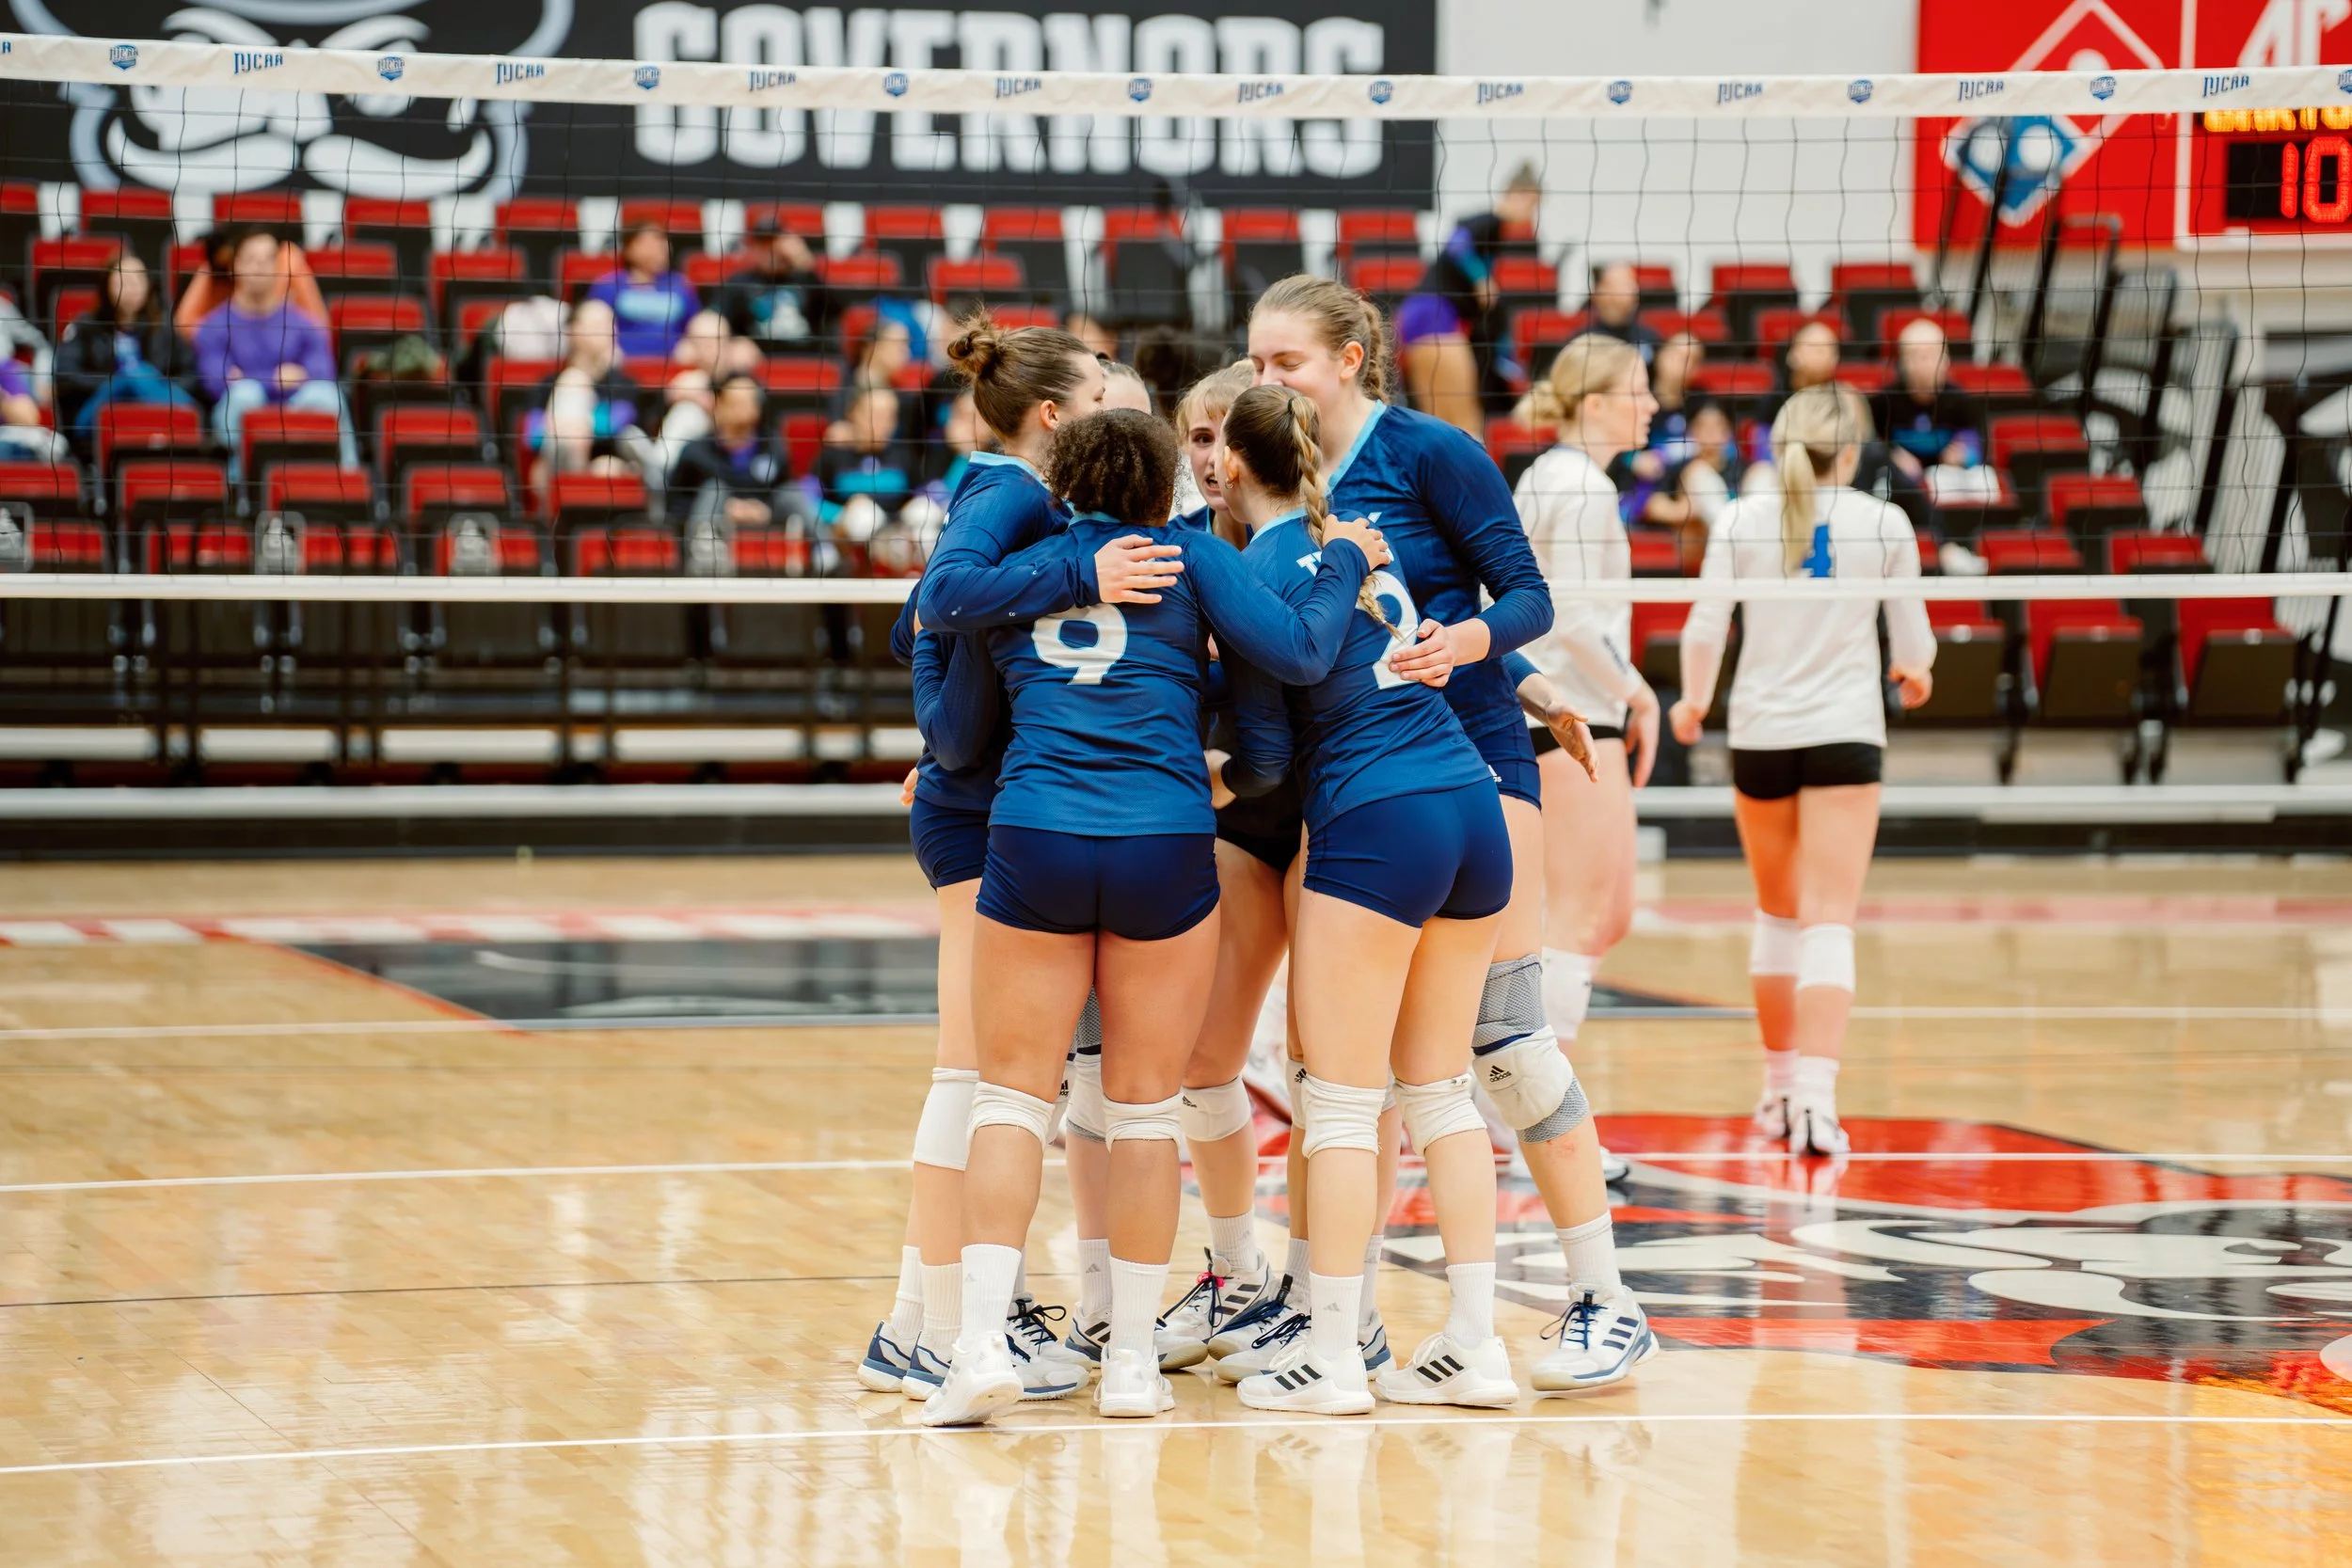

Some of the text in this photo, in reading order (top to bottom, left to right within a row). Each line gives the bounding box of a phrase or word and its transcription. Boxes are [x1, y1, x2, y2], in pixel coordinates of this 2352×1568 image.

[234, 53, 283, 74] NJCAA
[497, 62, 545, 84] NJCAA
[634, 2, 1384, 179] GOVERNORS
[2203, 75, 2249, 98] NJCAA
[2280, 136, 2352, 223] 10
[1031, 602, 1127, 685] 9
[1355, 570, 1424, 689] 2
